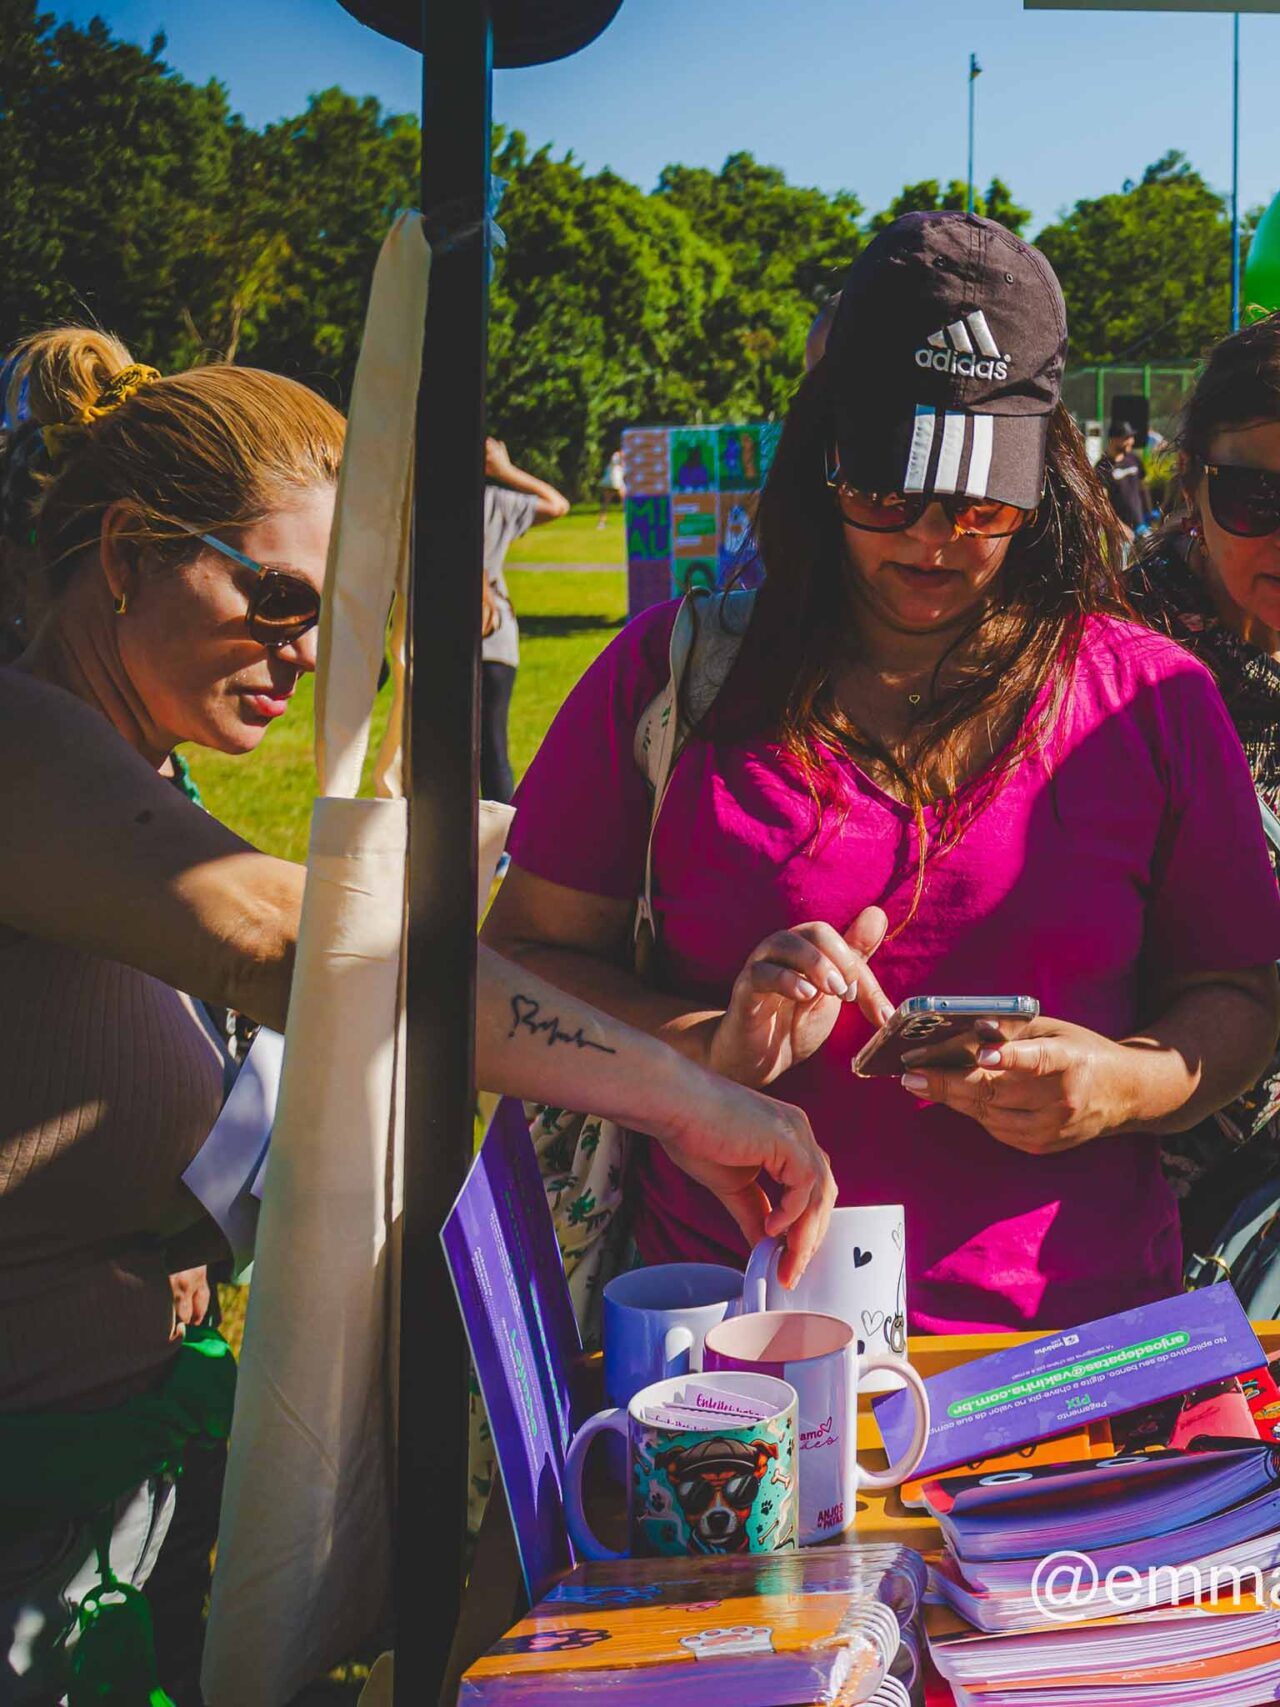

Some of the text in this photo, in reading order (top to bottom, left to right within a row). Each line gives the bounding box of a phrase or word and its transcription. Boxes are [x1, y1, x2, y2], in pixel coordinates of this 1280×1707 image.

[914, 349, 1008, 381] adidas
[1170, 1341, 1213, 1358] aplicativo
[953, 1334, 1185, 1415] anjosdepatas@vakinha.com.br
[989, 1404, 1014, 1416] valor
[1056, 1400, 1108, 1420] Pagamento
[1065, 1393, 1092, 1410] PIX
[799, 1429, 824, 1441] amo
[817, 1502, 844, 1521] ANJOS
